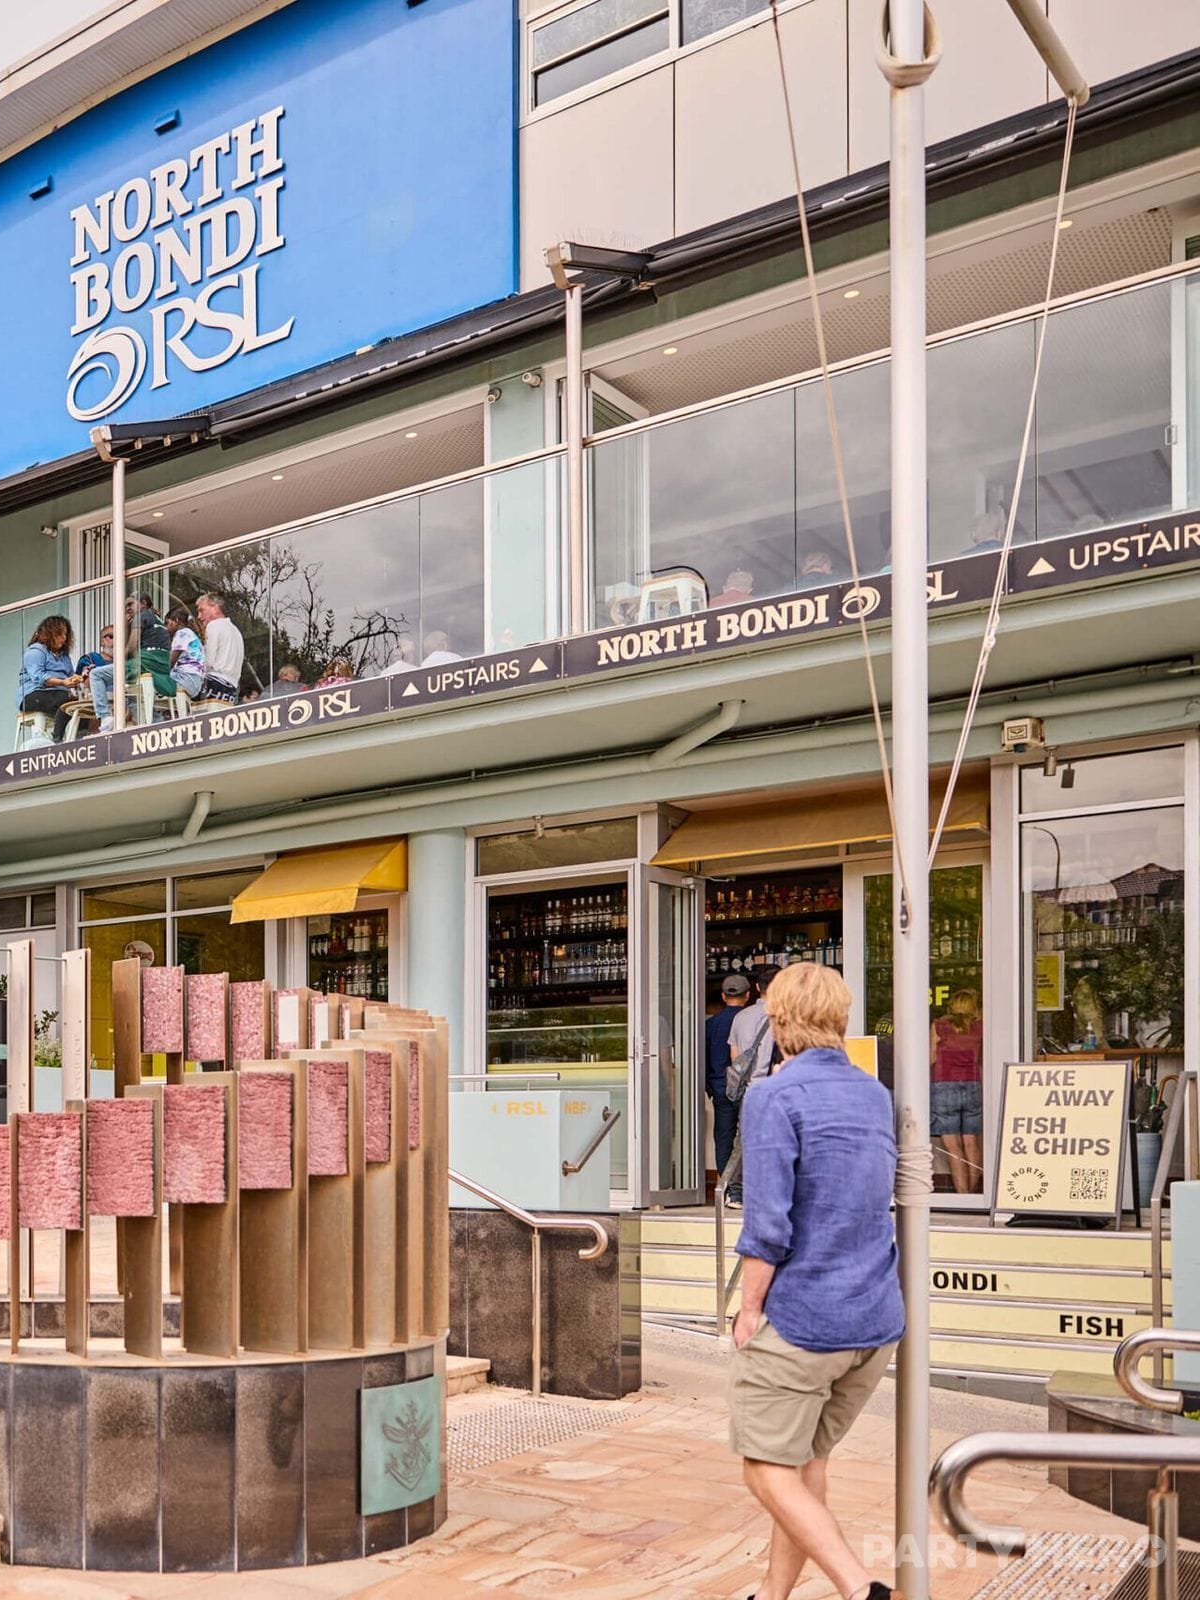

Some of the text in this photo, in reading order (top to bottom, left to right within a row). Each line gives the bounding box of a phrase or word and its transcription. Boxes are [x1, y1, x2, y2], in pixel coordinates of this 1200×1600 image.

[70, 105, 285, 266] NORTH
[70, 176, 285, 337] BONDI
[149, 263, 295, 390] RSL
[1069, 523, 1200, 570] UPSTAIR
[597, 619, 707, 665] NORTH
[717, 594, 829, 642] BONDI
[427, 659, 521, 693] UPSTAIRS
[131, 689, 360, 755] NORTH BONDI RSL
[20, 745, 97, 774] ENTRANCE
[1016, 1070, 1076, 1087] TAKE
[506, 1101, 548, 1115] RSL
[1044, 1089, 1114, 1107] AWAY
[1012, 1117, 1066, 1134] FISH
[1010, 1137, 1110, 1156] & CHIPS
[1007, 1167, 1049, 1202] NORTH BONDI FISH
[930, 1271, 997, 1292] ONDI
[1059, 1314, 1124, 1338] FISH
